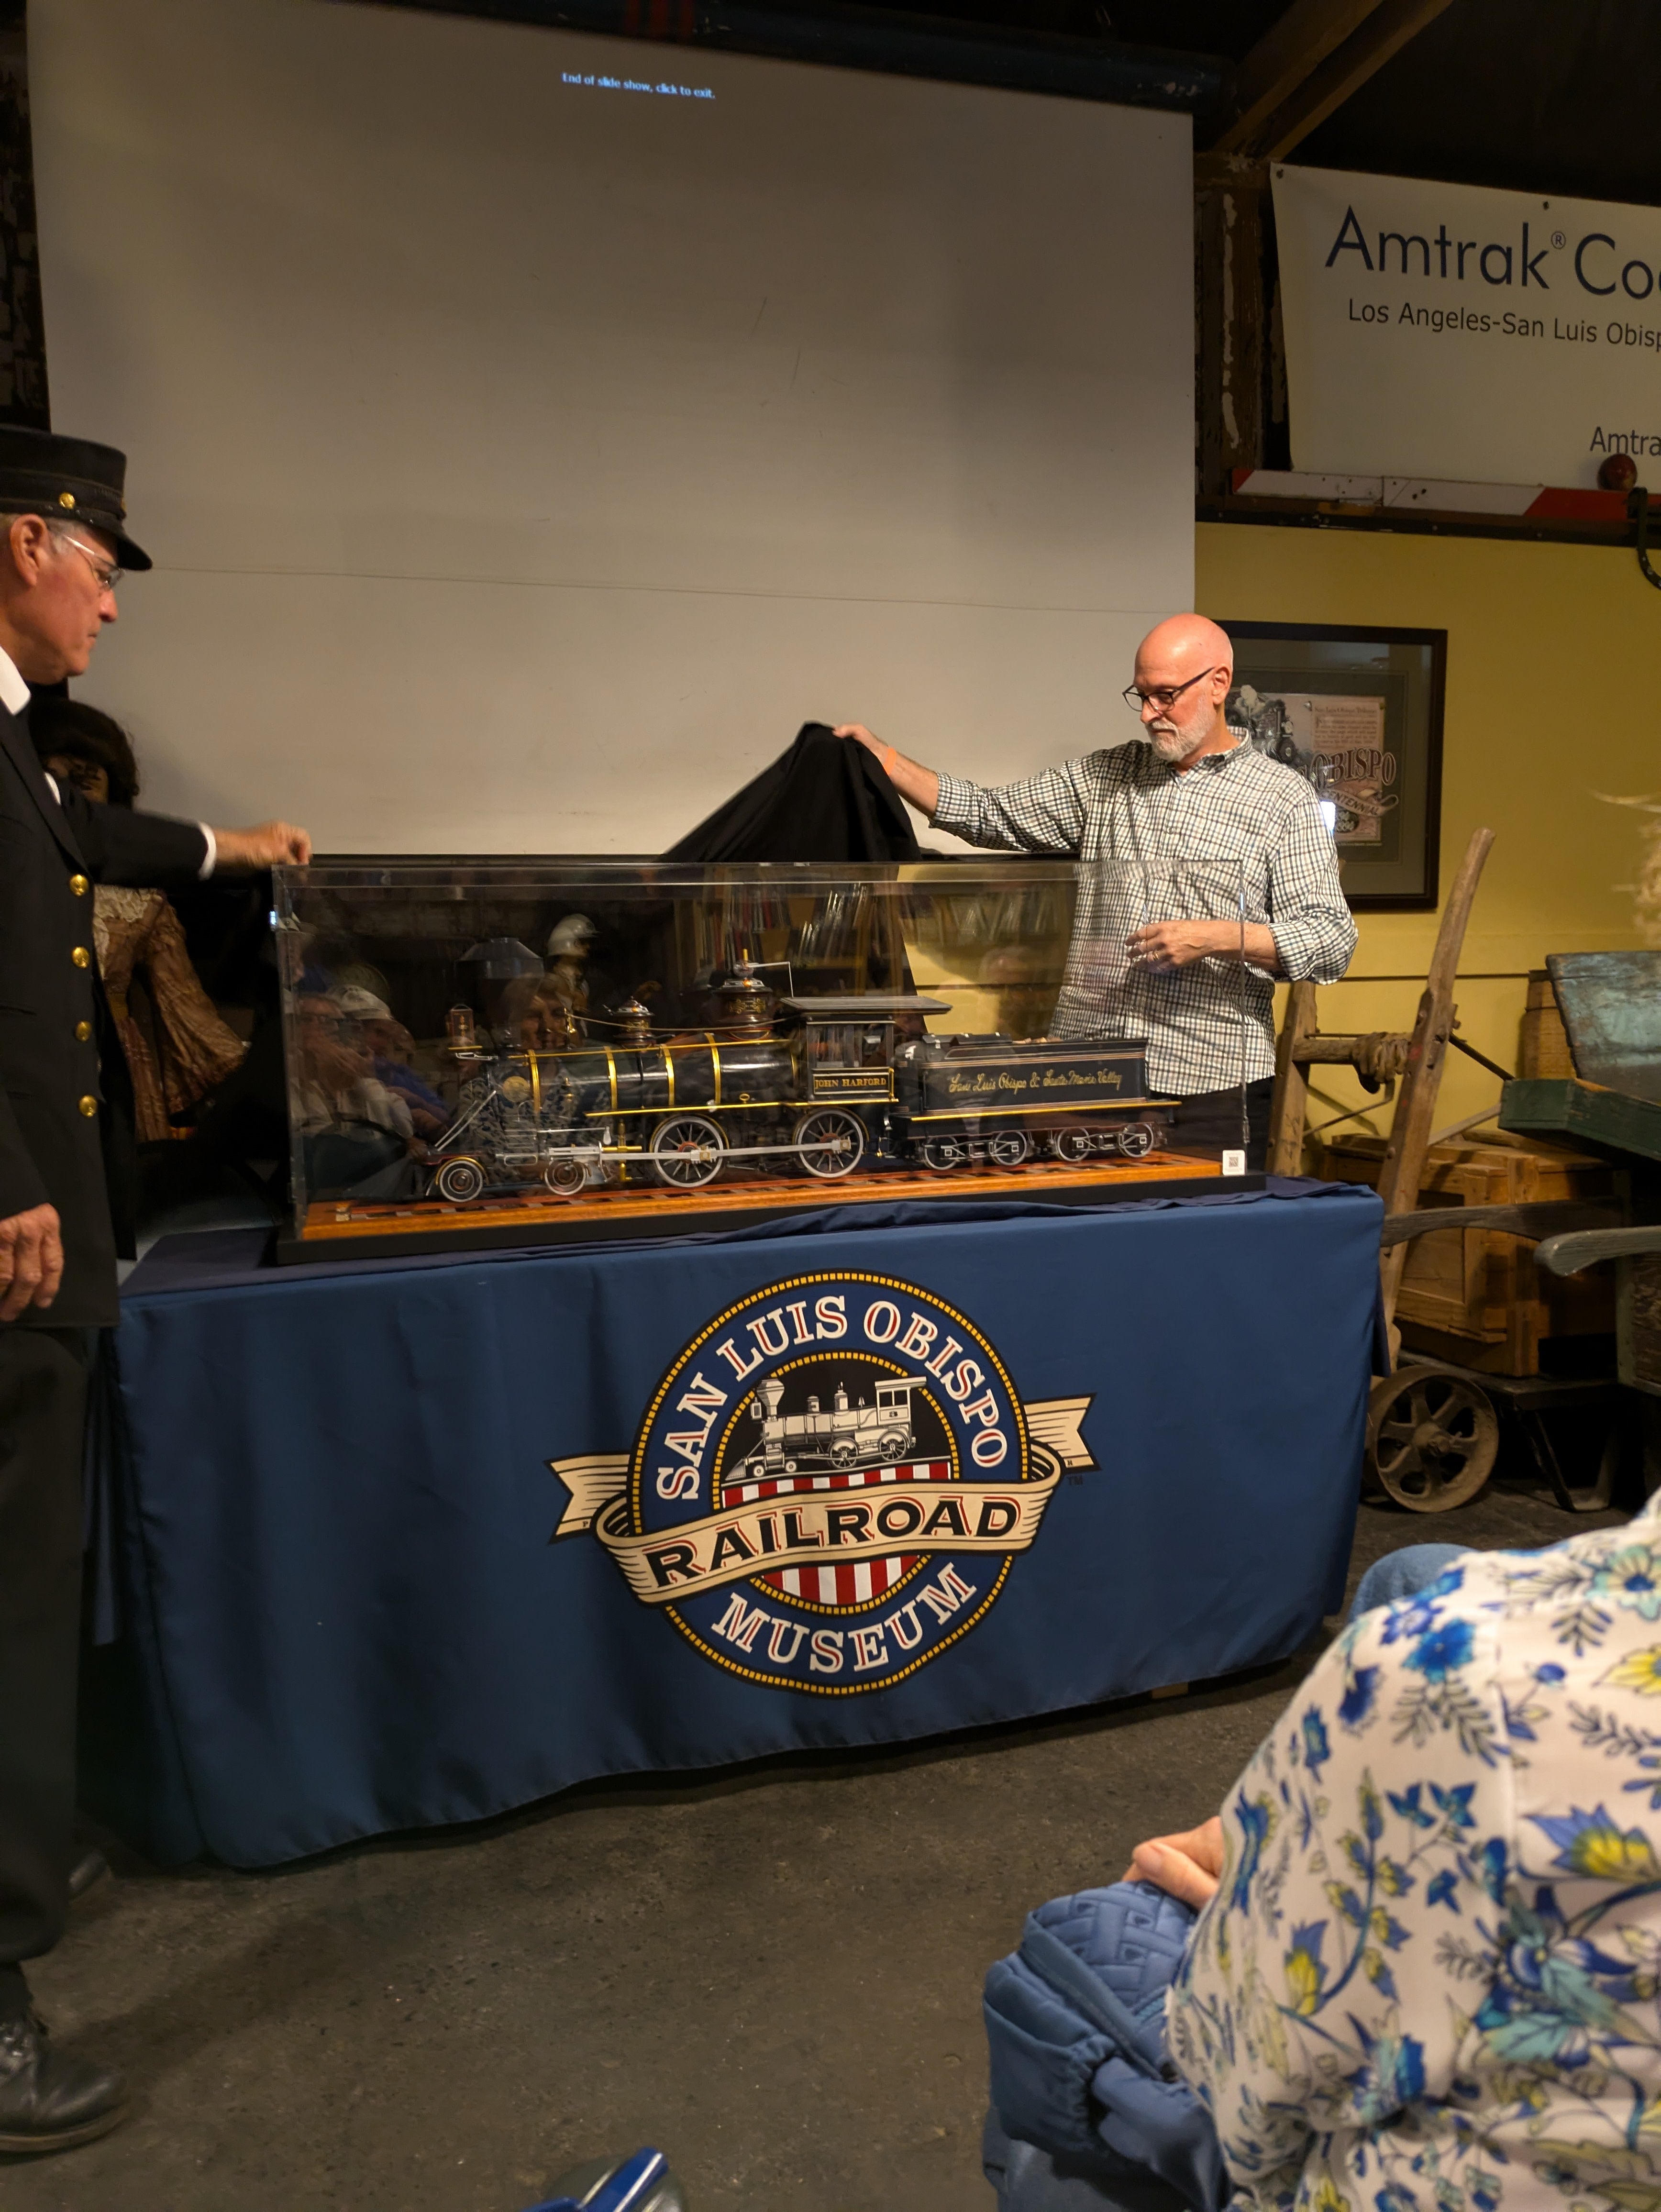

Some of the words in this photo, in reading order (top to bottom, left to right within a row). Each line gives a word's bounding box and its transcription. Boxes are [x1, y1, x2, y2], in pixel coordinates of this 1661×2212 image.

[562, 73, 581, 84] End
[584, 75, 595, 86] of
[598, 77, 620, 88] slide
[623, 79, 653, 93] show,
[656, 83, 677, 94] click
[680, 86, 692, 96] to
[694, 88, 716, 99] exit.
[1574, 233, 1661, 300] Co
[1349, 298, 1389, 323] Los
[1398, 302, 1544, 337] Angeles-San
[1554, 318, 1597, 343] Luis
[1310, 747, 1396, 791] OBISPO
[815, 1079, 839, 1089] JOHN
[842, 1077, 886, 1087] HARFORD
[949, 1073, 971, 1093] San
[973, 1073, 996, 1092] Luis
[998, 1072, 1027, 1095] Obispo
[1030, 1072, 1041, 1088] &
[656, 1372, 728, 1500] SAN
[716, 1294, 849, 1382] LUIS
[864, 1299, 1008, 1468] OBISPO
[642, 1495, 1021, 1588] RAILROAD
[711, 1562, 977, 1673] MUSEUM
